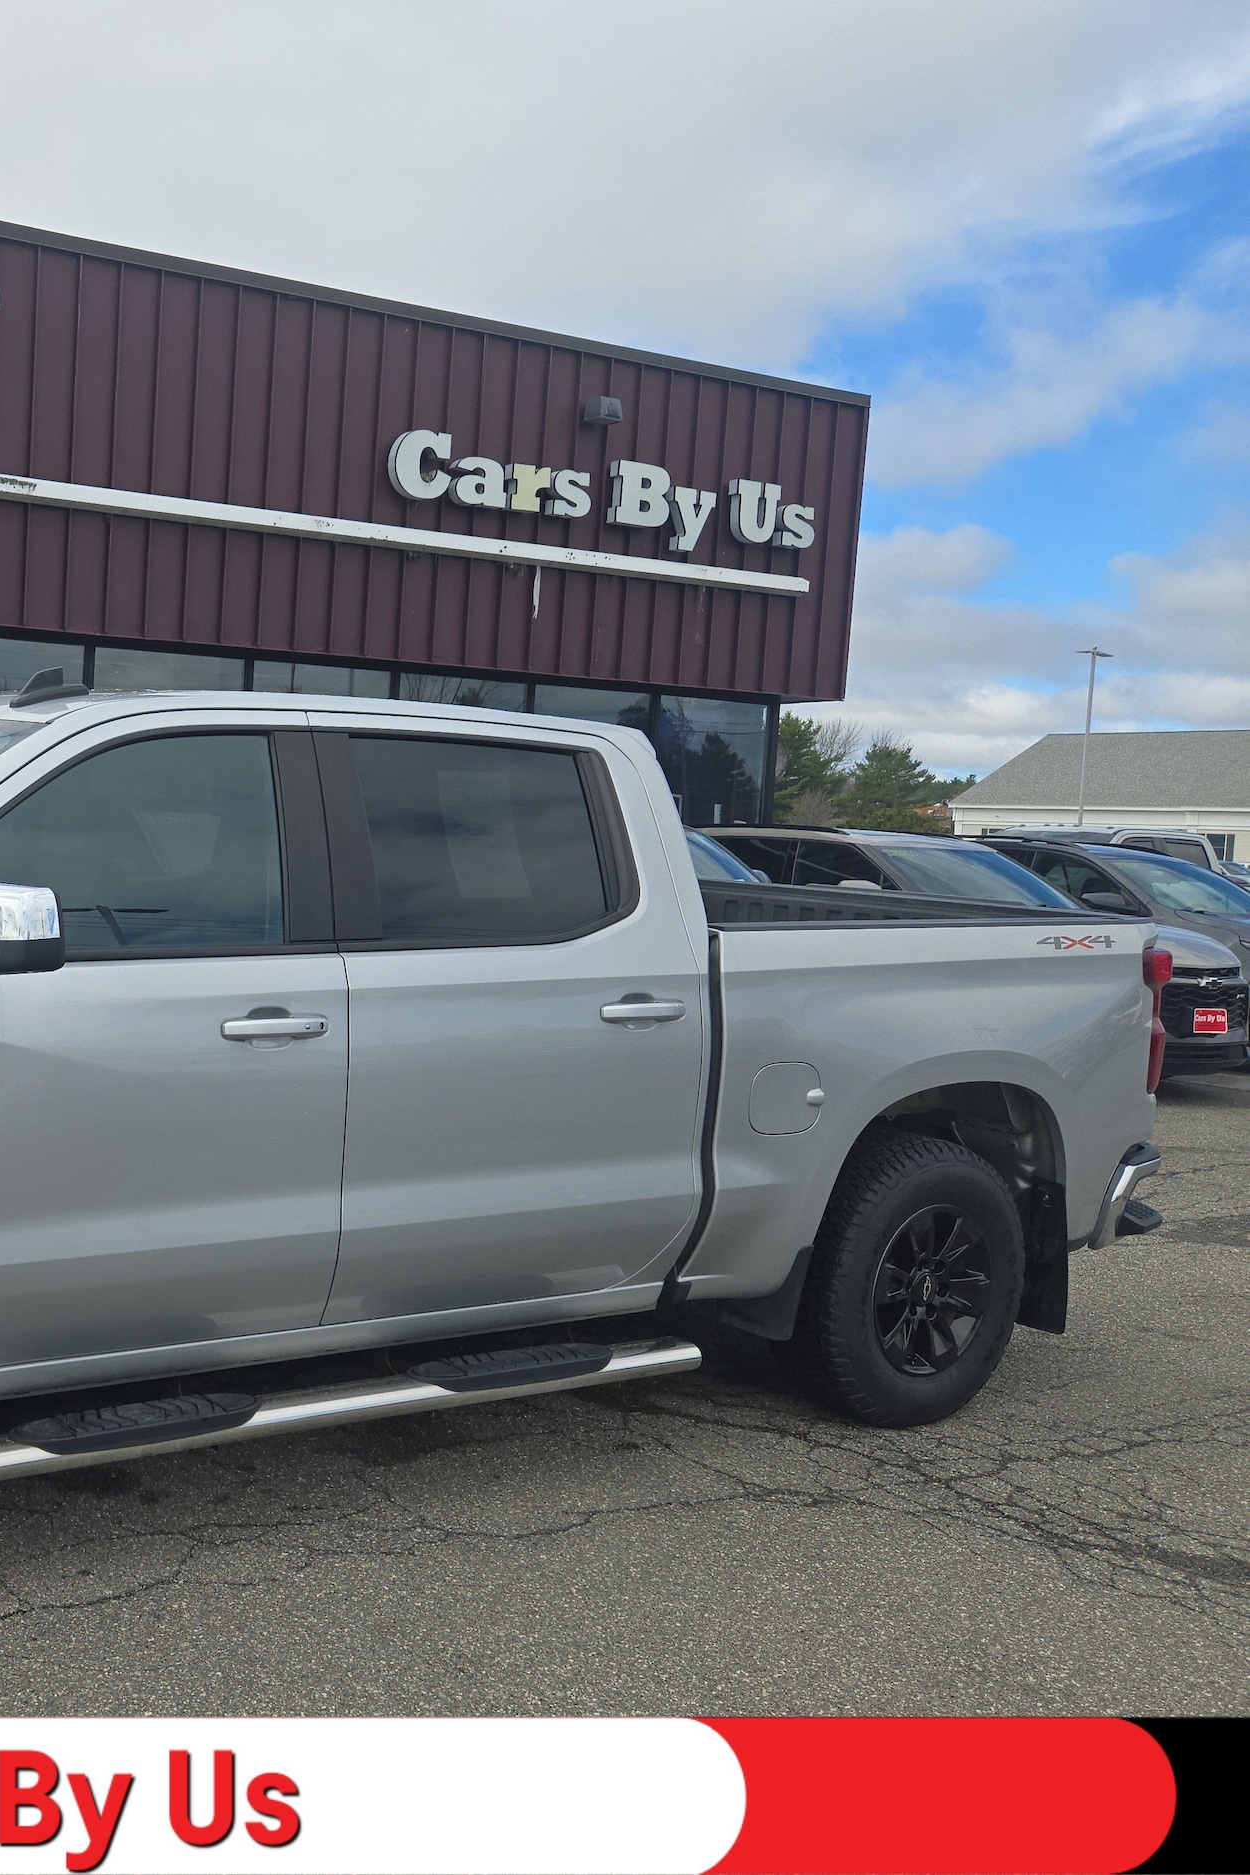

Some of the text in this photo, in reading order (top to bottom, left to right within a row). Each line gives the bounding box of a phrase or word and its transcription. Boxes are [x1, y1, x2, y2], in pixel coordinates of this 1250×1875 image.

[388, 428, 816, 552] Cars By Us
